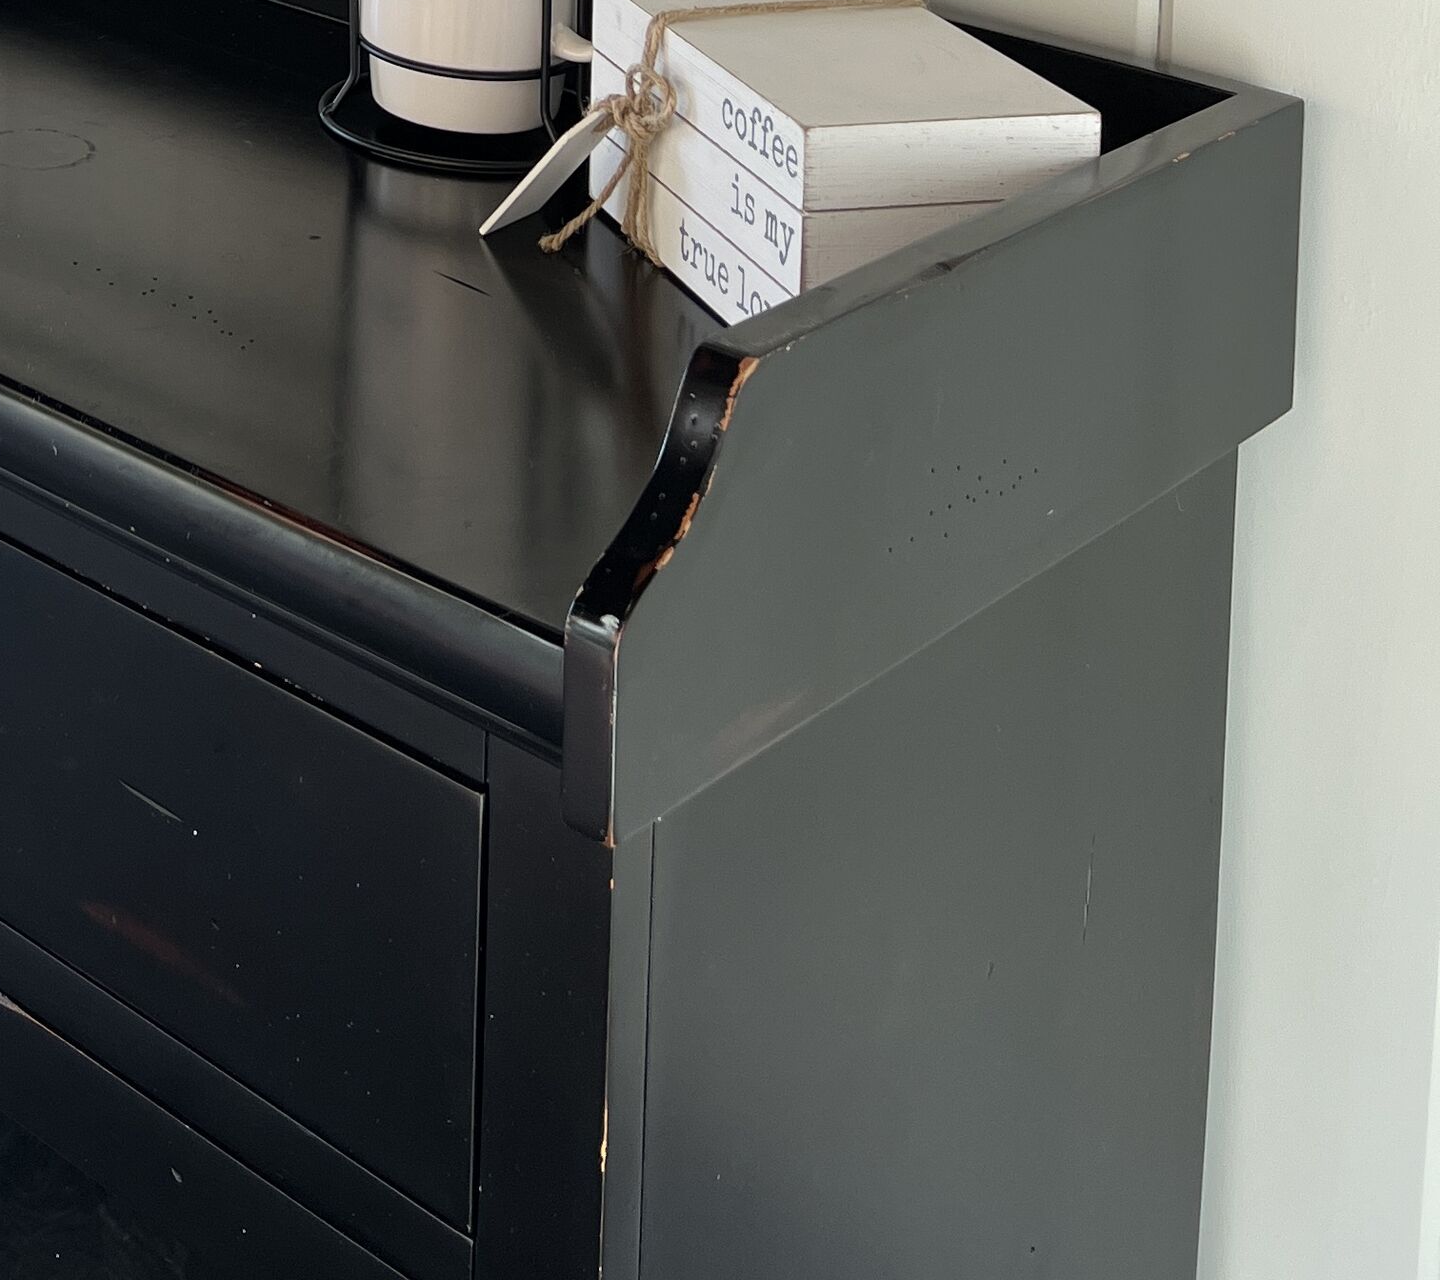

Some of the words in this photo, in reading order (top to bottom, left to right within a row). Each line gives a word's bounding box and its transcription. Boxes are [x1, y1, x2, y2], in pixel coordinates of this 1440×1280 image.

[722, 97, 799, 178] coffee
[730, 172, 755, 226] is
[764, 208, 795, 266] my
[679, 217, 729, 295] true
[736, 265, 772, 317] lo
